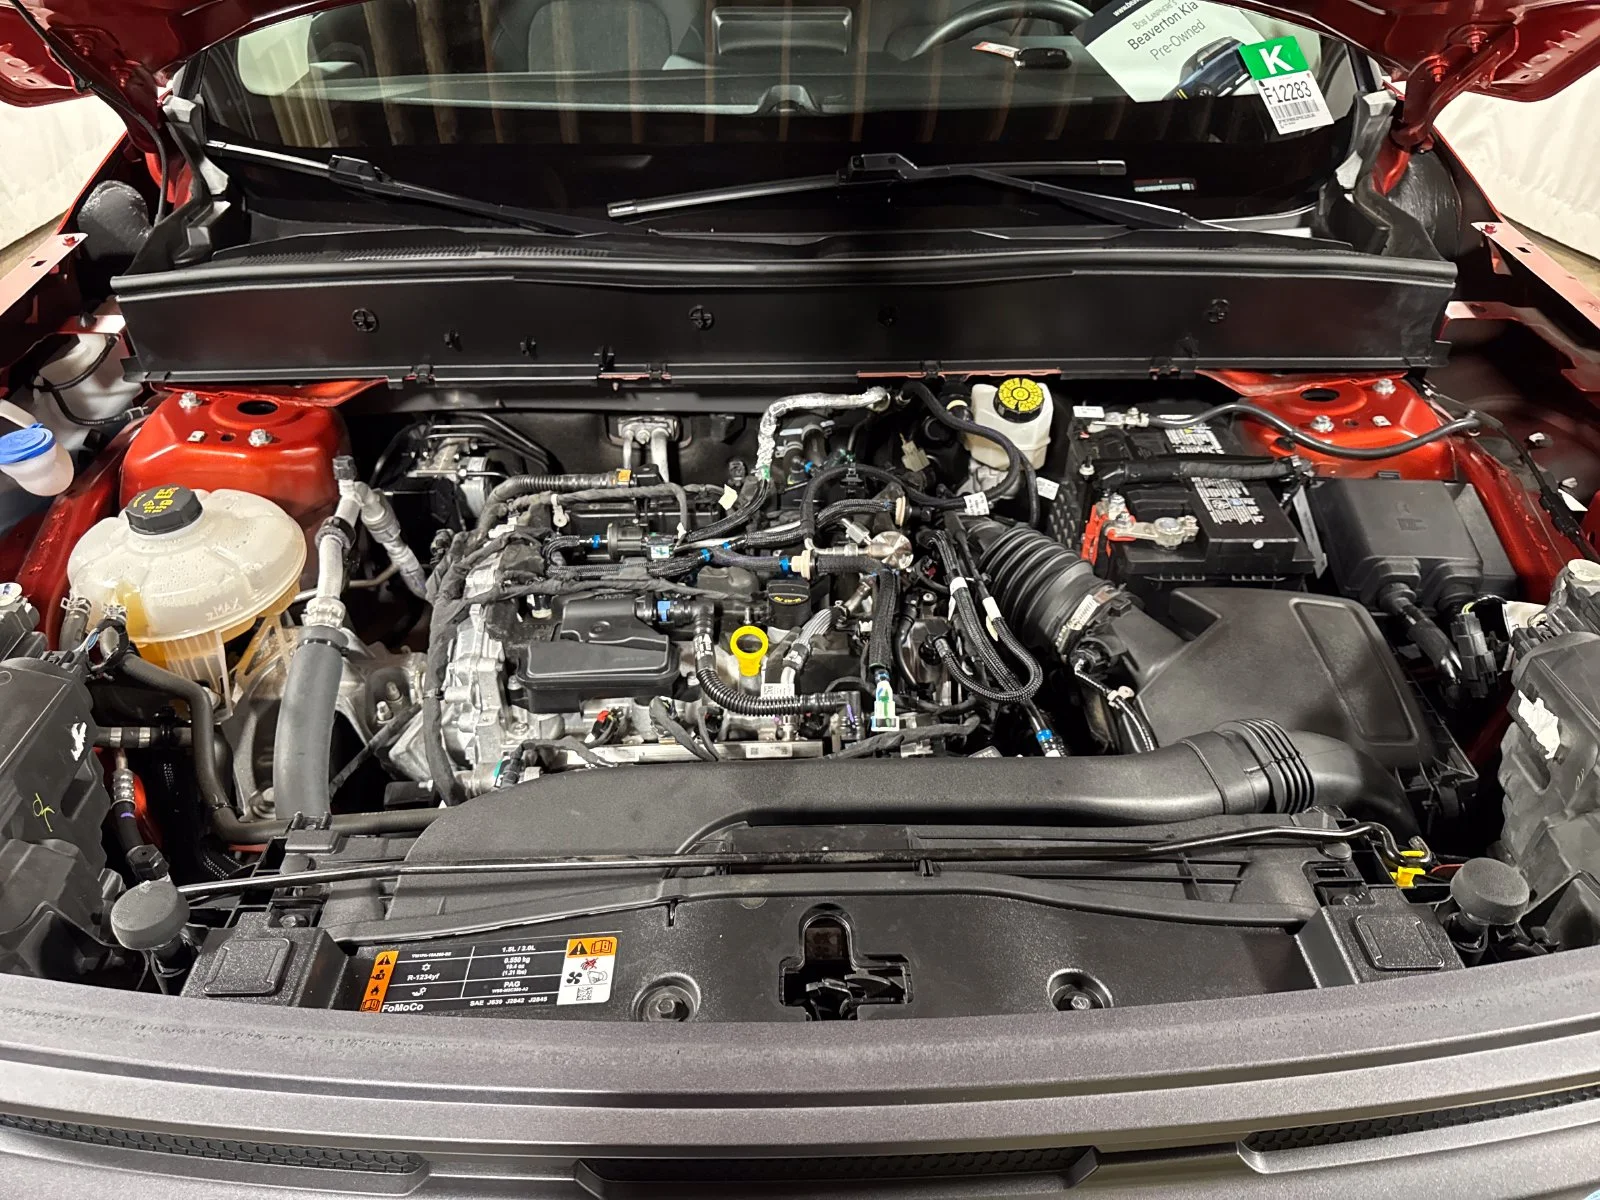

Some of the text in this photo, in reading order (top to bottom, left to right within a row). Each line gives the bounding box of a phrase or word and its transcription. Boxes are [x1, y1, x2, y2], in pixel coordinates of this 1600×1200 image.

[1127, 1, 1199, 50] Beaverton Kia
[1149, 19, 1206, 60] Pre-Owned
[1258, 45, 1294, 75] K
[1263, 81, 1312, 105] F12283
[407, 973, 440, 981] R-1234yf
[503, 980, 521, 988] PAG
[381, 1002, 424, 1013] FoMoCo
